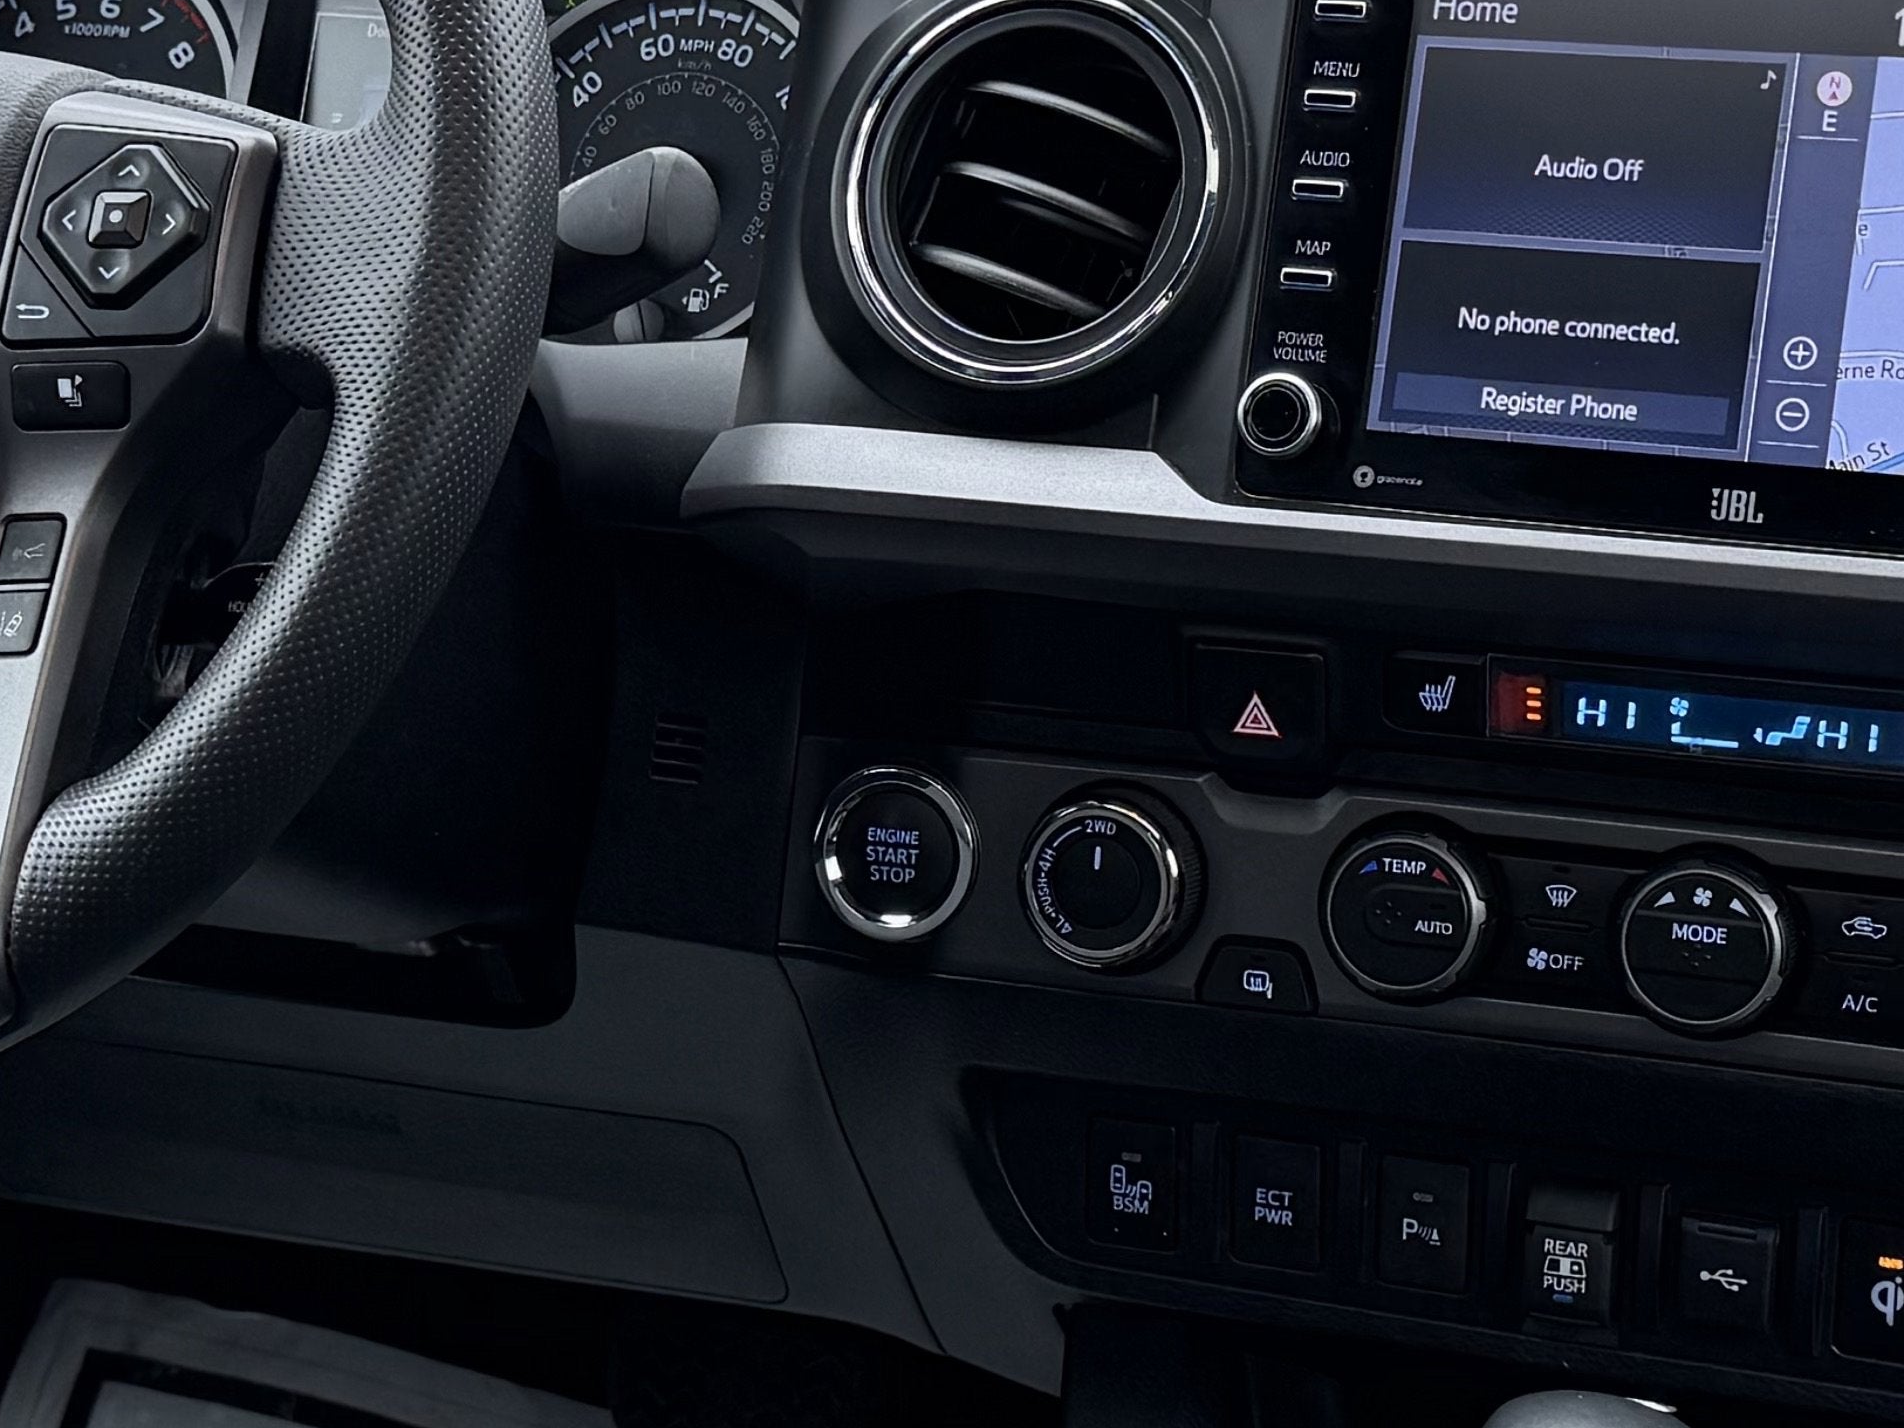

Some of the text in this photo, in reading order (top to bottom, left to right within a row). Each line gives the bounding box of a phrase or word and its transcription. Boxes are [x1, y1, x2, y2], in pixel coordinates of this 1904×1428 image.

[14, 9, 36, 39] 4
[139, 6, 166, 33] 7
[167, 40, 195, 70] 8
[640, 33, 674, 61] 60
[679, 37, 715, 53] MPH
[717, 38, 753, 68] 80
[1313, 60, 1360, 77] MENU
[572, 71, 603, 108] 40
[657, 80, 682, 96] 100
[691, 80, 716, 97] 120
[625, 90, 645, 111] 80
[722, 91, 746, 115] 140
[598, 114, 617, 135] 60
[747, 116, 765, 141] 160
[1822, 109, 1838, 132] E
[760, 148, 776, 174] 180
[1300, 150, 1350, 167] AUDIO
[1534, 154, 1645, 182] Audio Off
[758, 180, 775, 212] 200
[742, 215, 764, 245] 220
[1295, 239, 1332, 255] MAP
[713, 282, 730, 300] F
[1457, 306, 1681, 345] No phone connected.
[1277, 330, 1324, 347] POWER
[1273, 347, 1327, 363] VOLUME
[1480, 386, 1638, 421] Register Phone
[1867, 440, 1889, 460] St
[1710, 487, 1764, 525] JBL
[867, 826, 919, 845] ENGINE
[1084, 819, 1116, 835] 2WD
[866, 845, 919, 865] START
[870, 864, 915, 884] STOP
[1381, 857, 1427, 876] TEMP
[1414, 919, 1453, 936] AUTO
[1671, 922, 1728, 945] MODE
[1549, 954, 1585, 971] OFF
[1841, 993, 1879, 1013] A/C
[1112, 1195, 1150, 1215] BSM
[1255, 1187, 1293, 1206] ECT
[1254, 1206, 1293, 1227] PWR
[1544, 1238, 1589, 1258] REAR
[1542, 1275, 1586, 1294] PUSH
